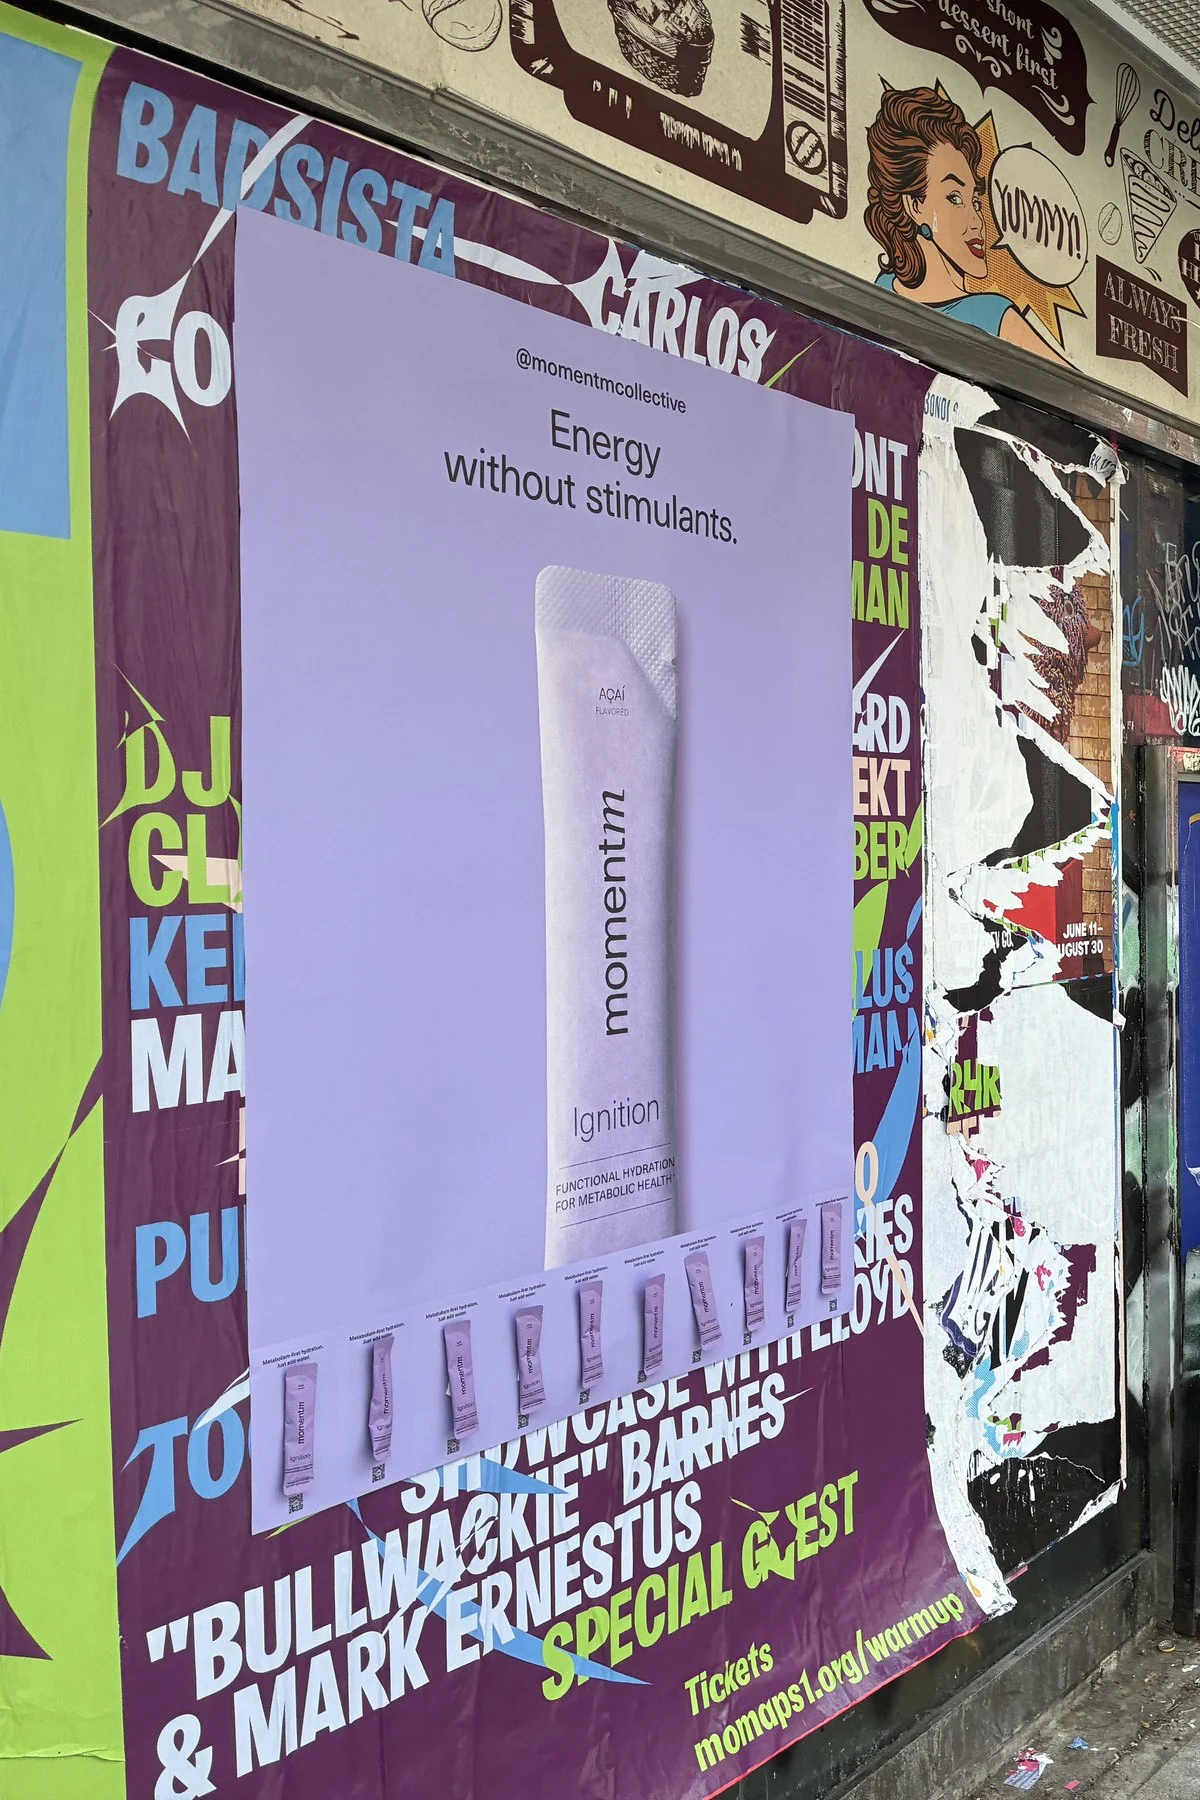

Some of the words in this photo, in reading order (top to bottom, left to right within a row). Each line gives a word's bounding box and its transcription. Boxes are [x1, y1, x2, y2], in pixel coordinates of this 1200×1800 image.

[116, 81, 455, 278] BADSISTA
[995, 178, 1082, 260] YUMMY!
[1104, 272, 1181, 334] ALWAYS
[1108, 313, 1180, 374] FRESH
[516, 348, 687, 413] @momentmcollective
[551, 408, 661, 479] Energy
[444, 447, 576, 509] without
[586, 480, 738, 545] stimulants.
[868, 497, 909, 566] DE
[595, 706, 629, 718] FLAVORED
[599, 686, 626, 704] AÇAÍ
[120, 712, 232, 812] DJ
[599, 788, 628, 1037] momentm
[1063, 923, 1087, 939] JUNE
[1091, 939, 1104, 954] 30
[574, 1097, 660, 1143] Ignition
[555, 1170, 621, 1196] FUNCTIONAL
[622, 1157, 676, 1180] HYDRATION
[555, 1197, 576, 1214] FOR
[578, 1183, 635, 1207] METABOLIC
[622, 1372, 786, 1506] BARNES
[234, 1604, 433, 1778] MARK
[445, 1481, 703, 1675] ERNESTUS
[541, 1540, 734, 1702] SPECIAL
[684, 1641, 774, 1717] Tickets
[693, 1592, 966, 1773] momaps1.org/warmup
